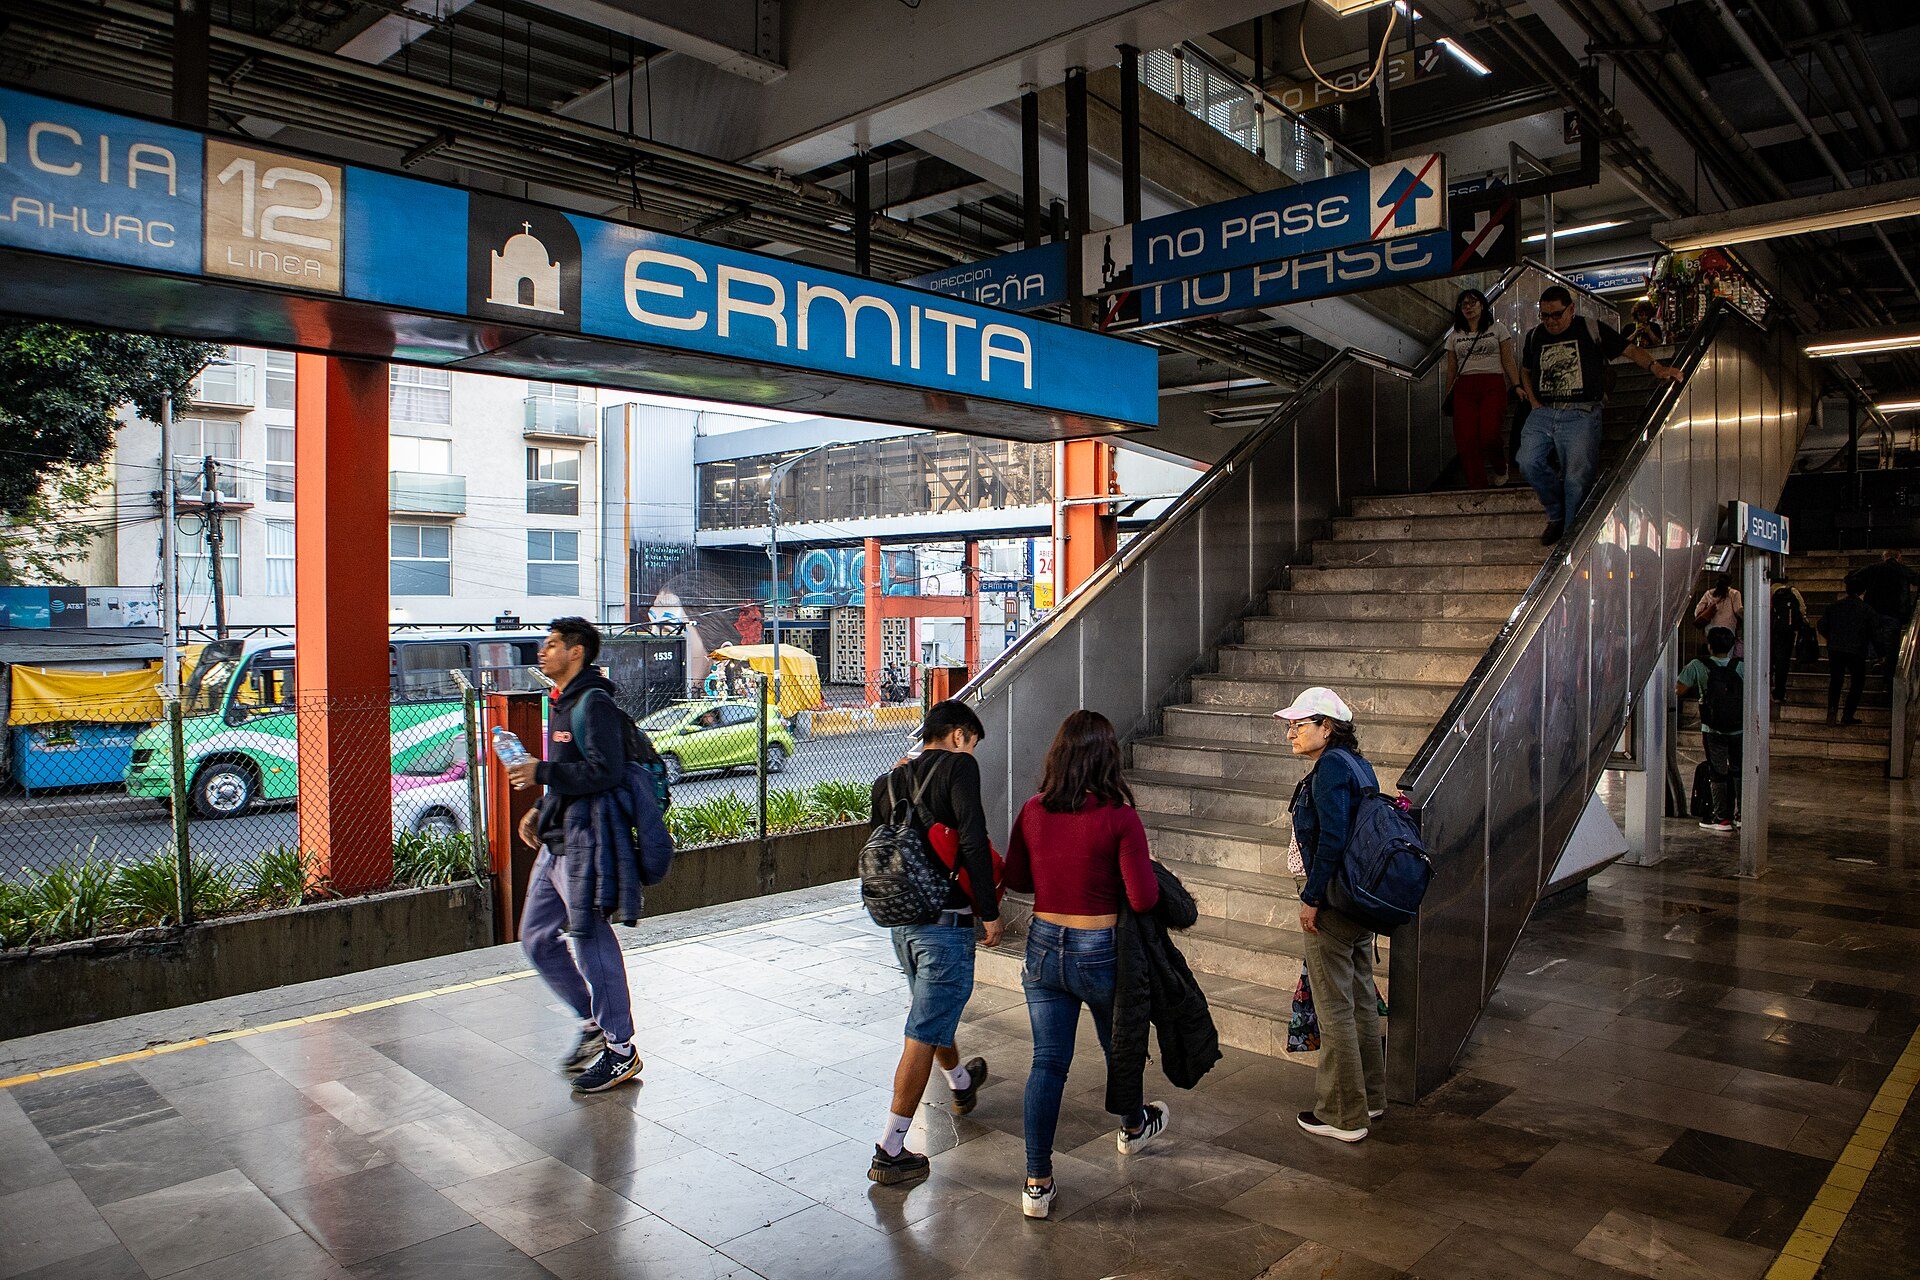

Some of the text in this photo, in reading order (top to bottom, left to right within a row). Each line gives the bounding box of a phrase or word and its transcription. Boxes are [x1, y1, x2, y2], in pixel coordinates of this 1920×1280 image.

[0, 117, 177, 196] CIA
[217, 158, 334, 251] 12
[1149, 195, 1349, 265] NO PASE
[227, 245, 321, 279] LINEA
[930, 267, 992, 291] DIRECCION
[624, 249, 1033, 390] ERMITA
[1752, 516, 1778, 541] SALIDA
[982, 582, 1013, 590] ERMITA
[653, 651, 673, 661] 1535
